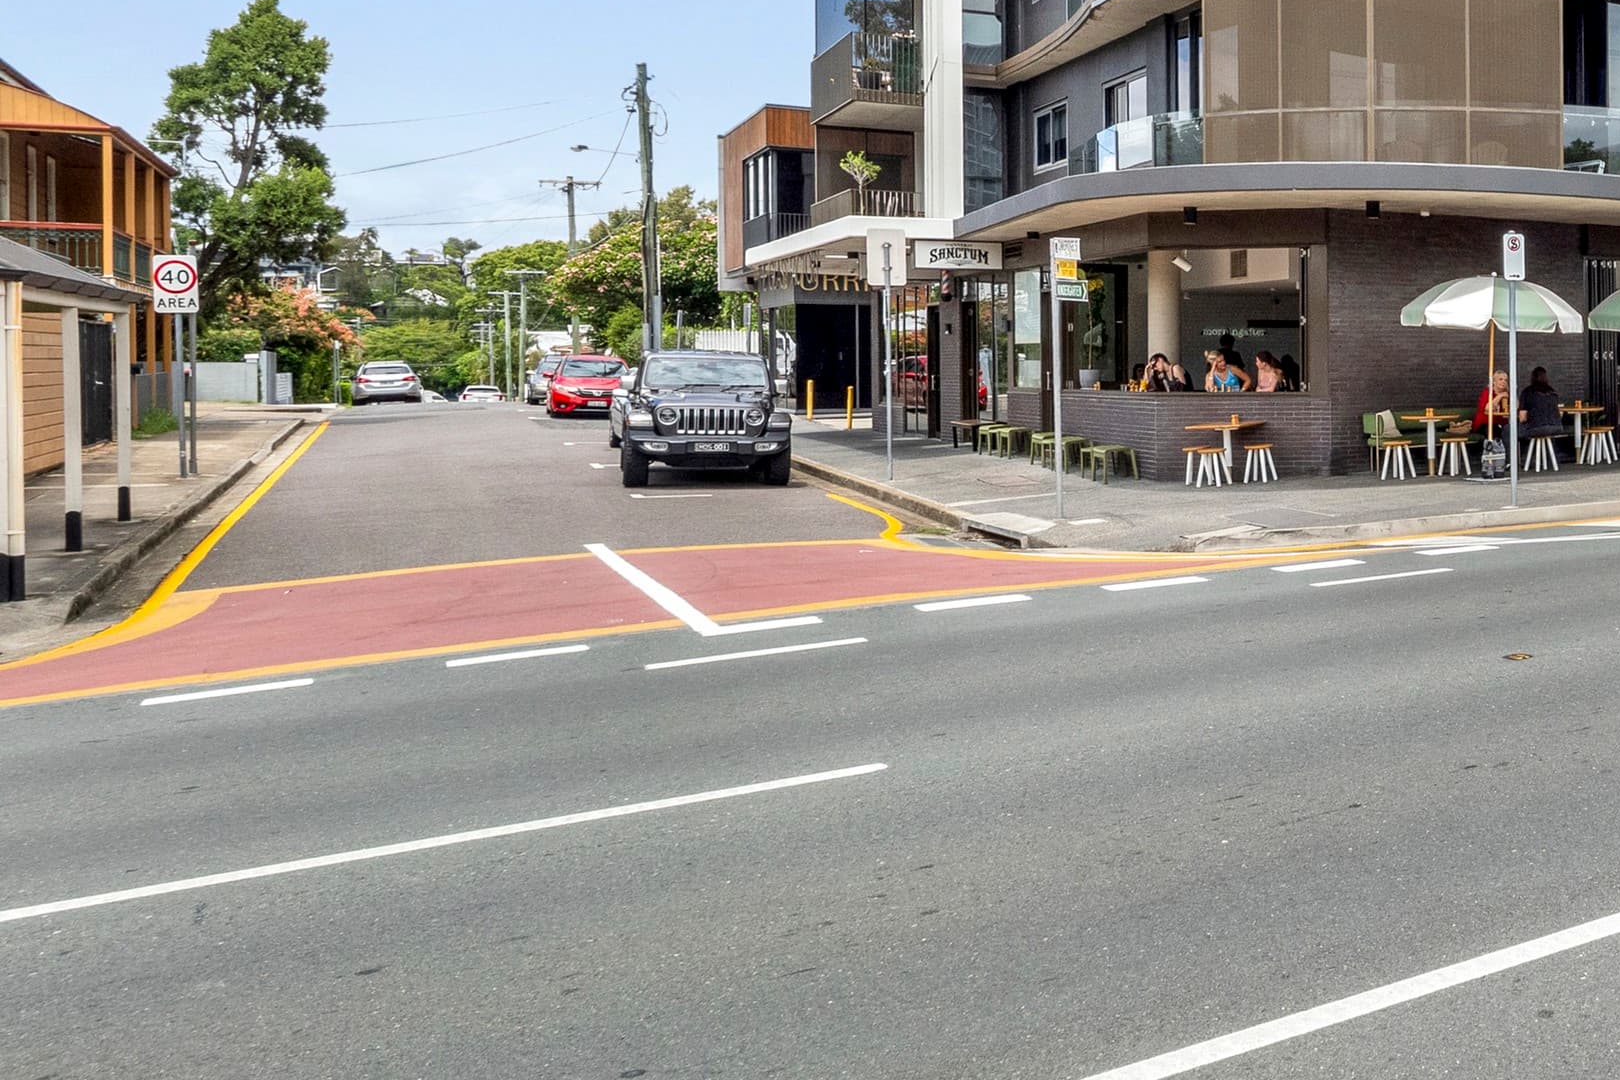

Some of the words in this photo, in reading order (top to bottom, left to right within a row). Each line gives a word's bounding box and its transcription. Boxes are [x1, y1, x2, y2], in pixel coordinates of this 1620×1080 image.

[929, 247, 990, 265] SANCTUM
[161, 270, 190, 284] 40
[157, 297, 198, 308] AREA
